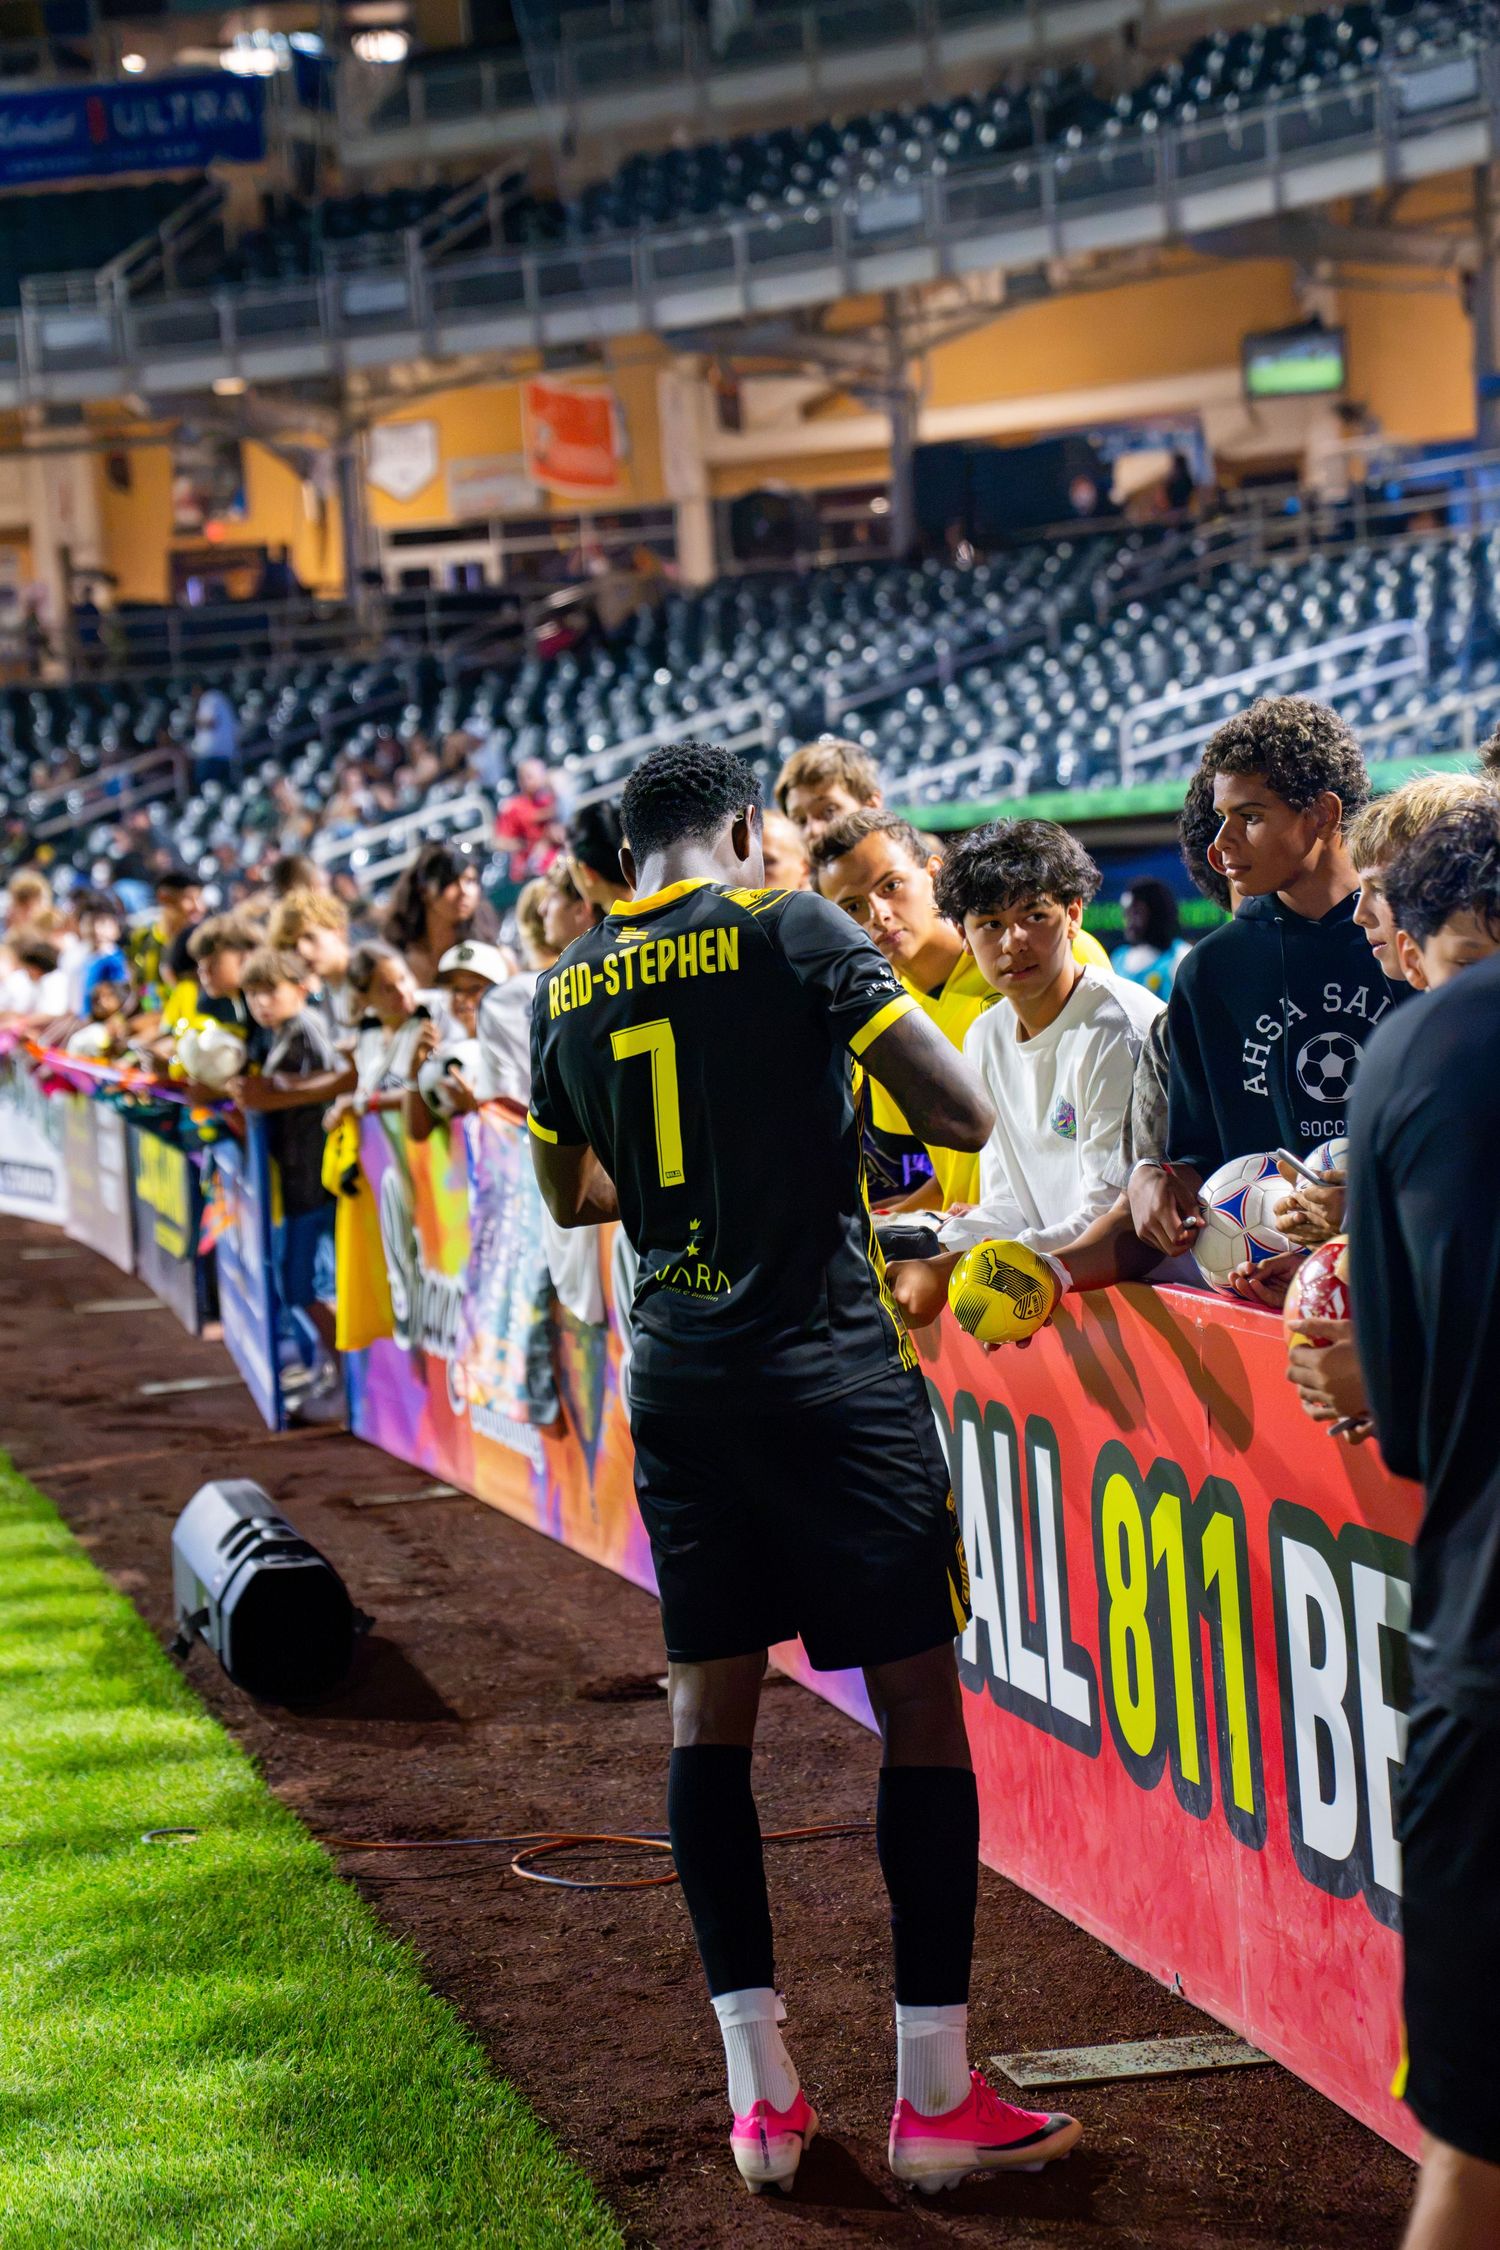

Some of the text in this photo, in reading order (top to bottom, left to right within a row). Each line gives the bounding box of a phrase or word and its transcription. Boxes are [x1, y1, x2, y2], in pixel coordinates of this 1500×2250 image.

[111, 89, 253, 138] ULTRA
[548, 926, 740, 1020] REID-STEPHEN
[1242, 996, 1308, 1097] AHSA
[609, 1017, 686, 1188] 7
[1299, 1120, 1351, 1137] SOCC
[932, 1404, 1092, 1728] ALL
[1102, 1472, 1255, 1816] 811
